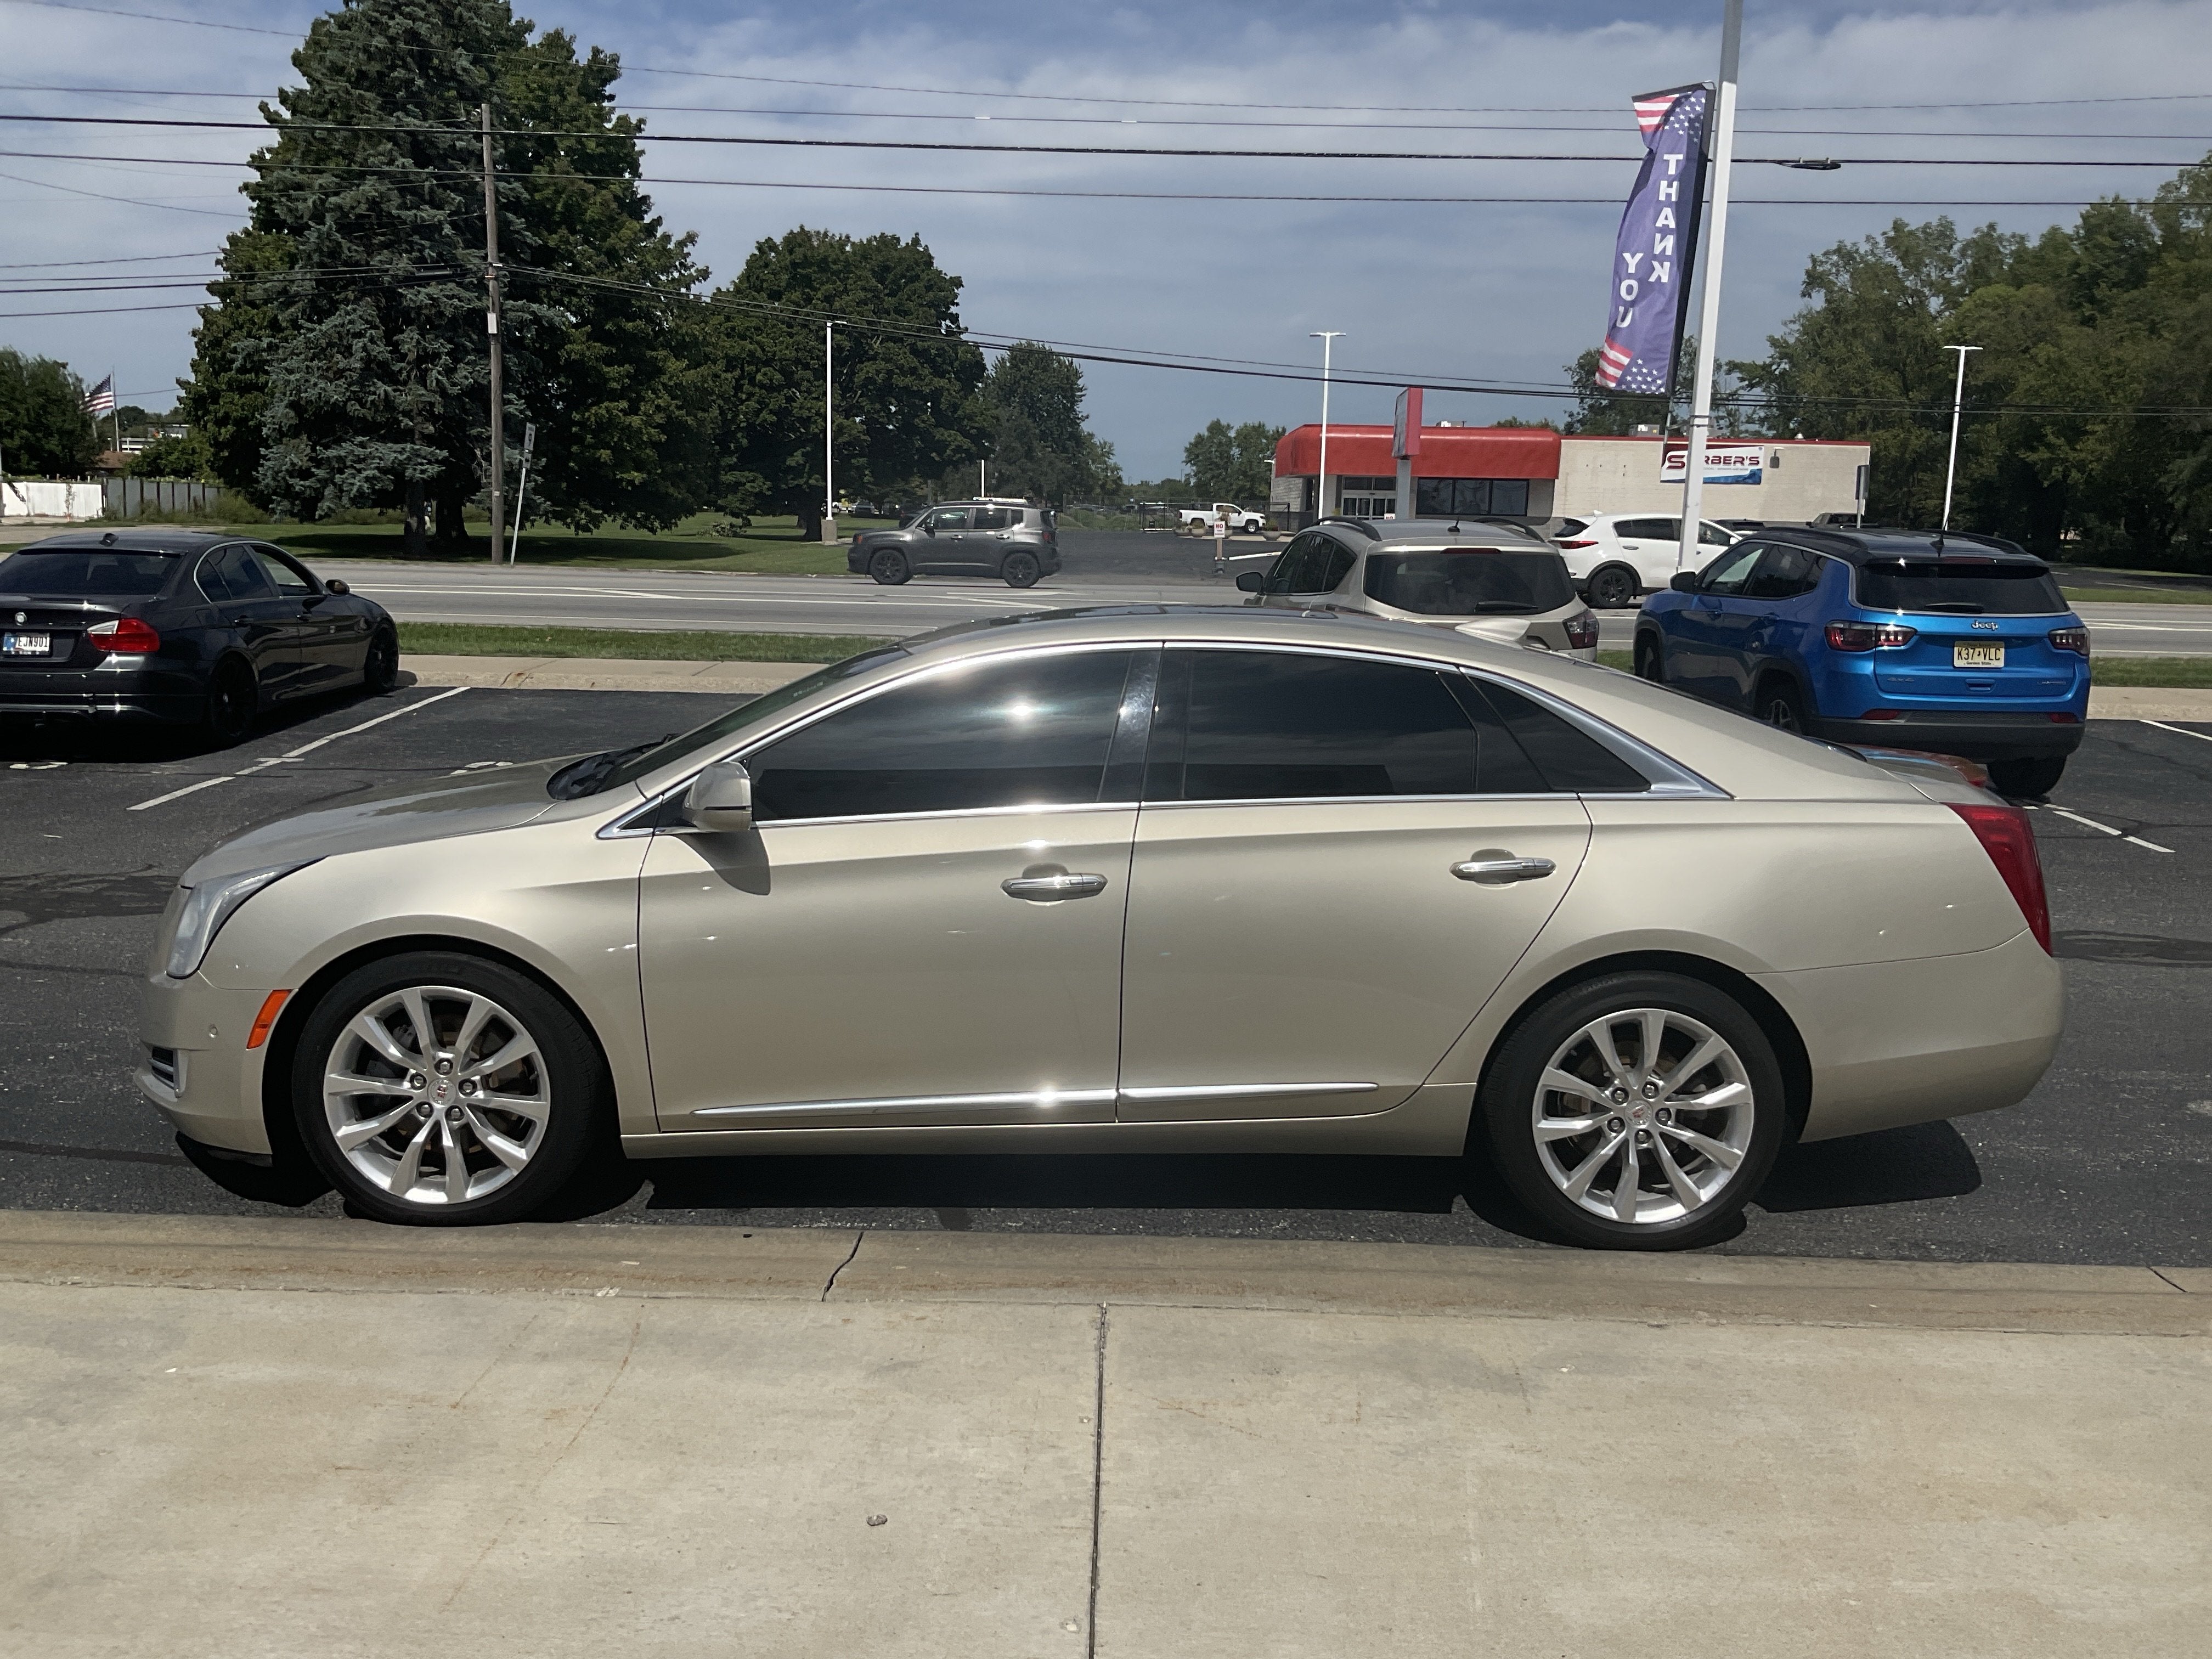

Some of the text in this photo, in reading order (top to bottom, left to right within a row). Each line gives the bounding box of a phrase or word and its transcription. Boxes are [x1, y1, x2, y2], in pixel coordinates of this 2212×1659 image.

[1666, 455, 1760, 470] SBER'S
[1971, 619, 1999, 631] Jeep
[1957, 648, 2001, 661] K37 VLC
